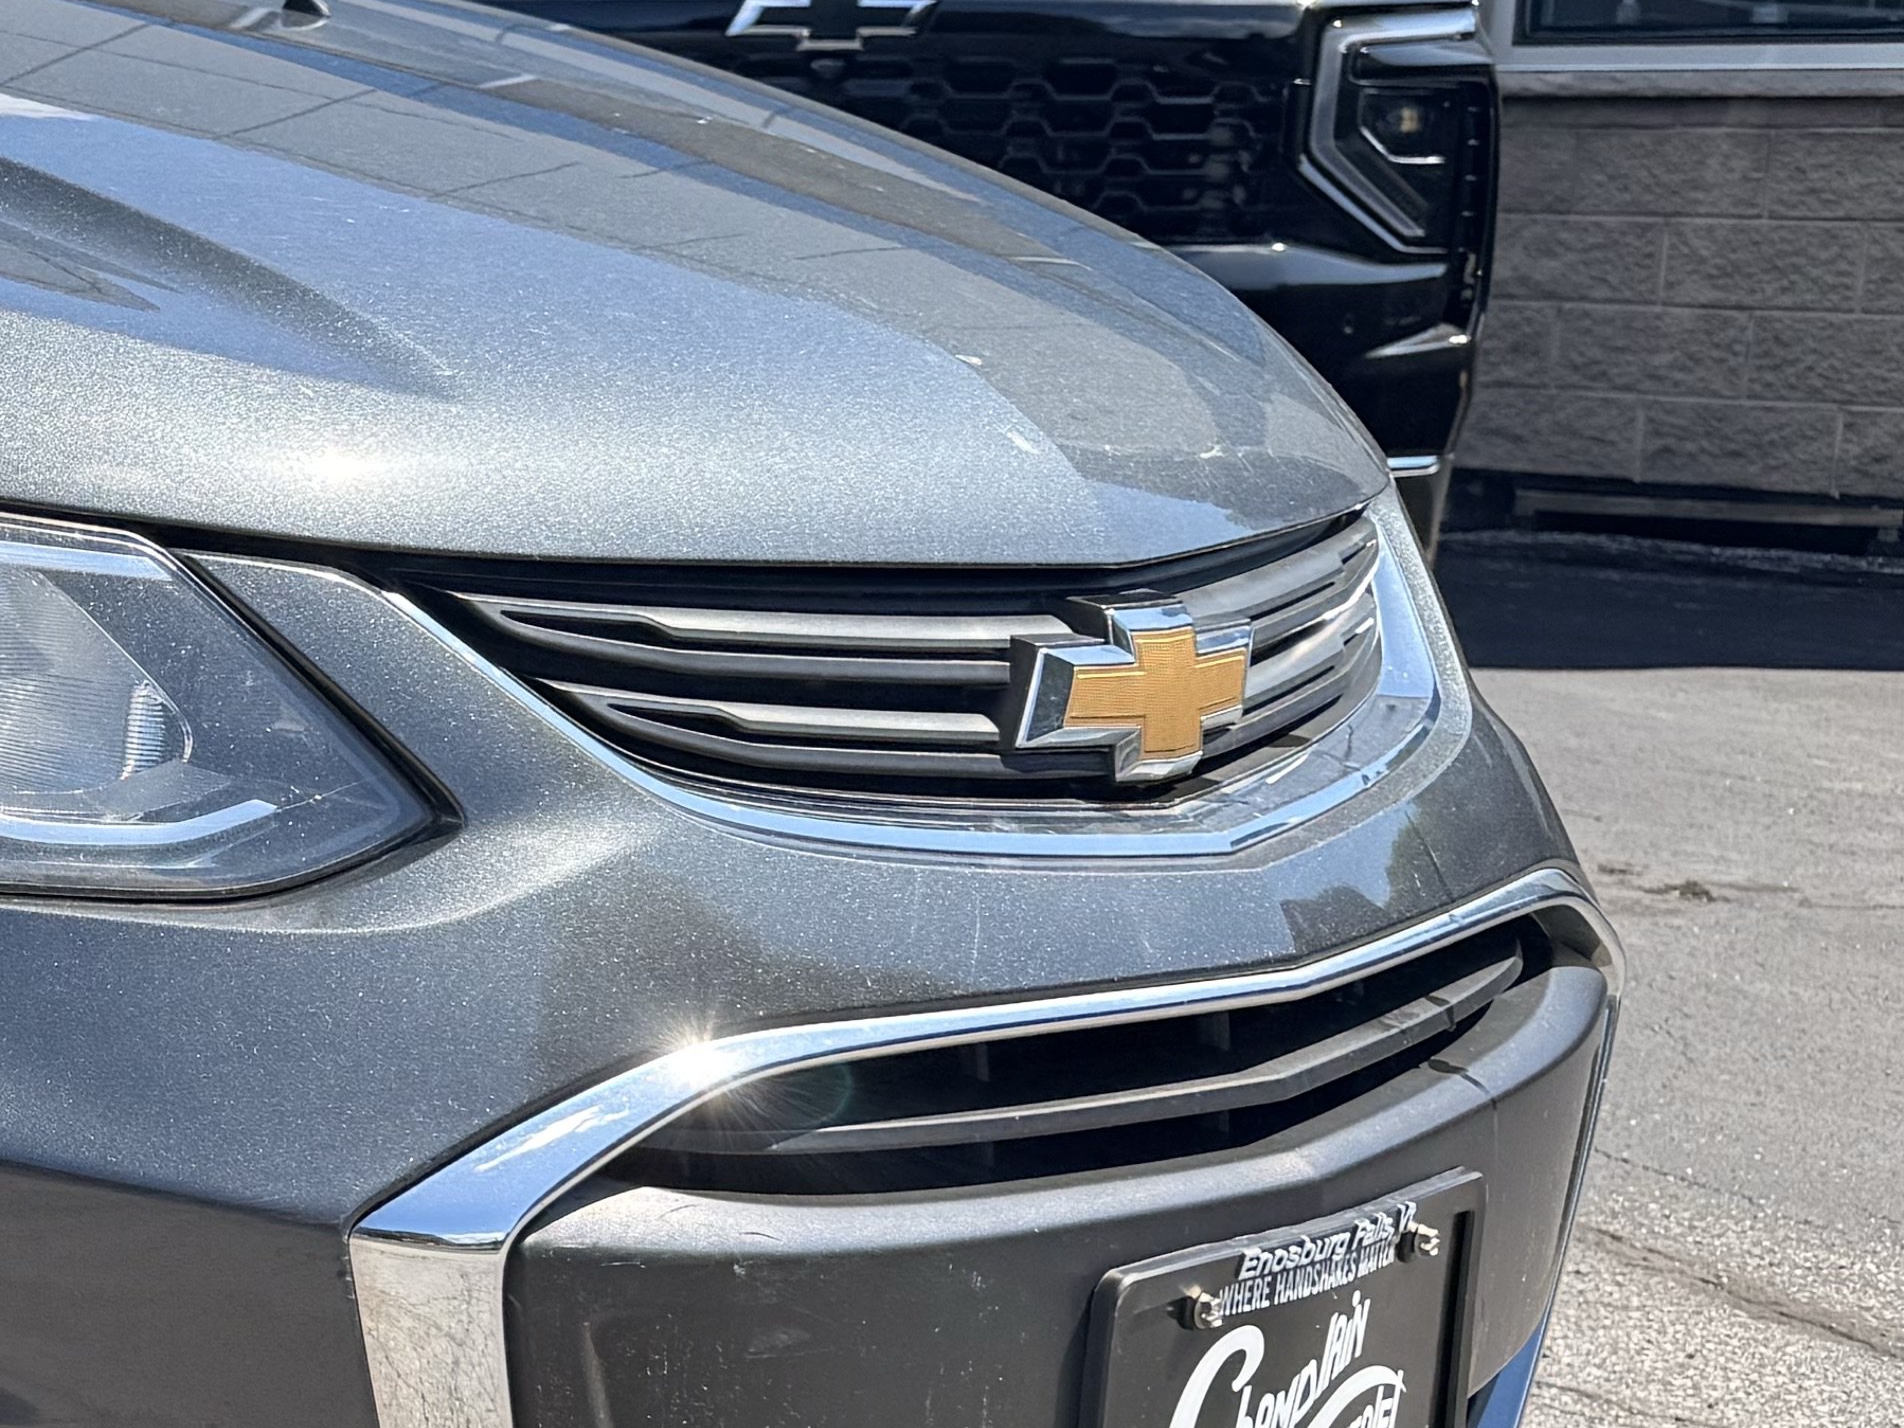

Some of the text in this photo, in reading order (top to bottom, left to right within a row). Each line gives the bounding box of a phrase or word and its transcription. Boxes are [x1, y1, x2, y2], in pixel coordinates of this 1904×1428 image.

[1239, 1232, 1351, 1280] Enosburg
[1352, 1212, 1395, 1251] Falls
[1218, 1275, 1272, 1316] WHERE
[1274, 1249, 1358, 1306] HANDSHAKES
